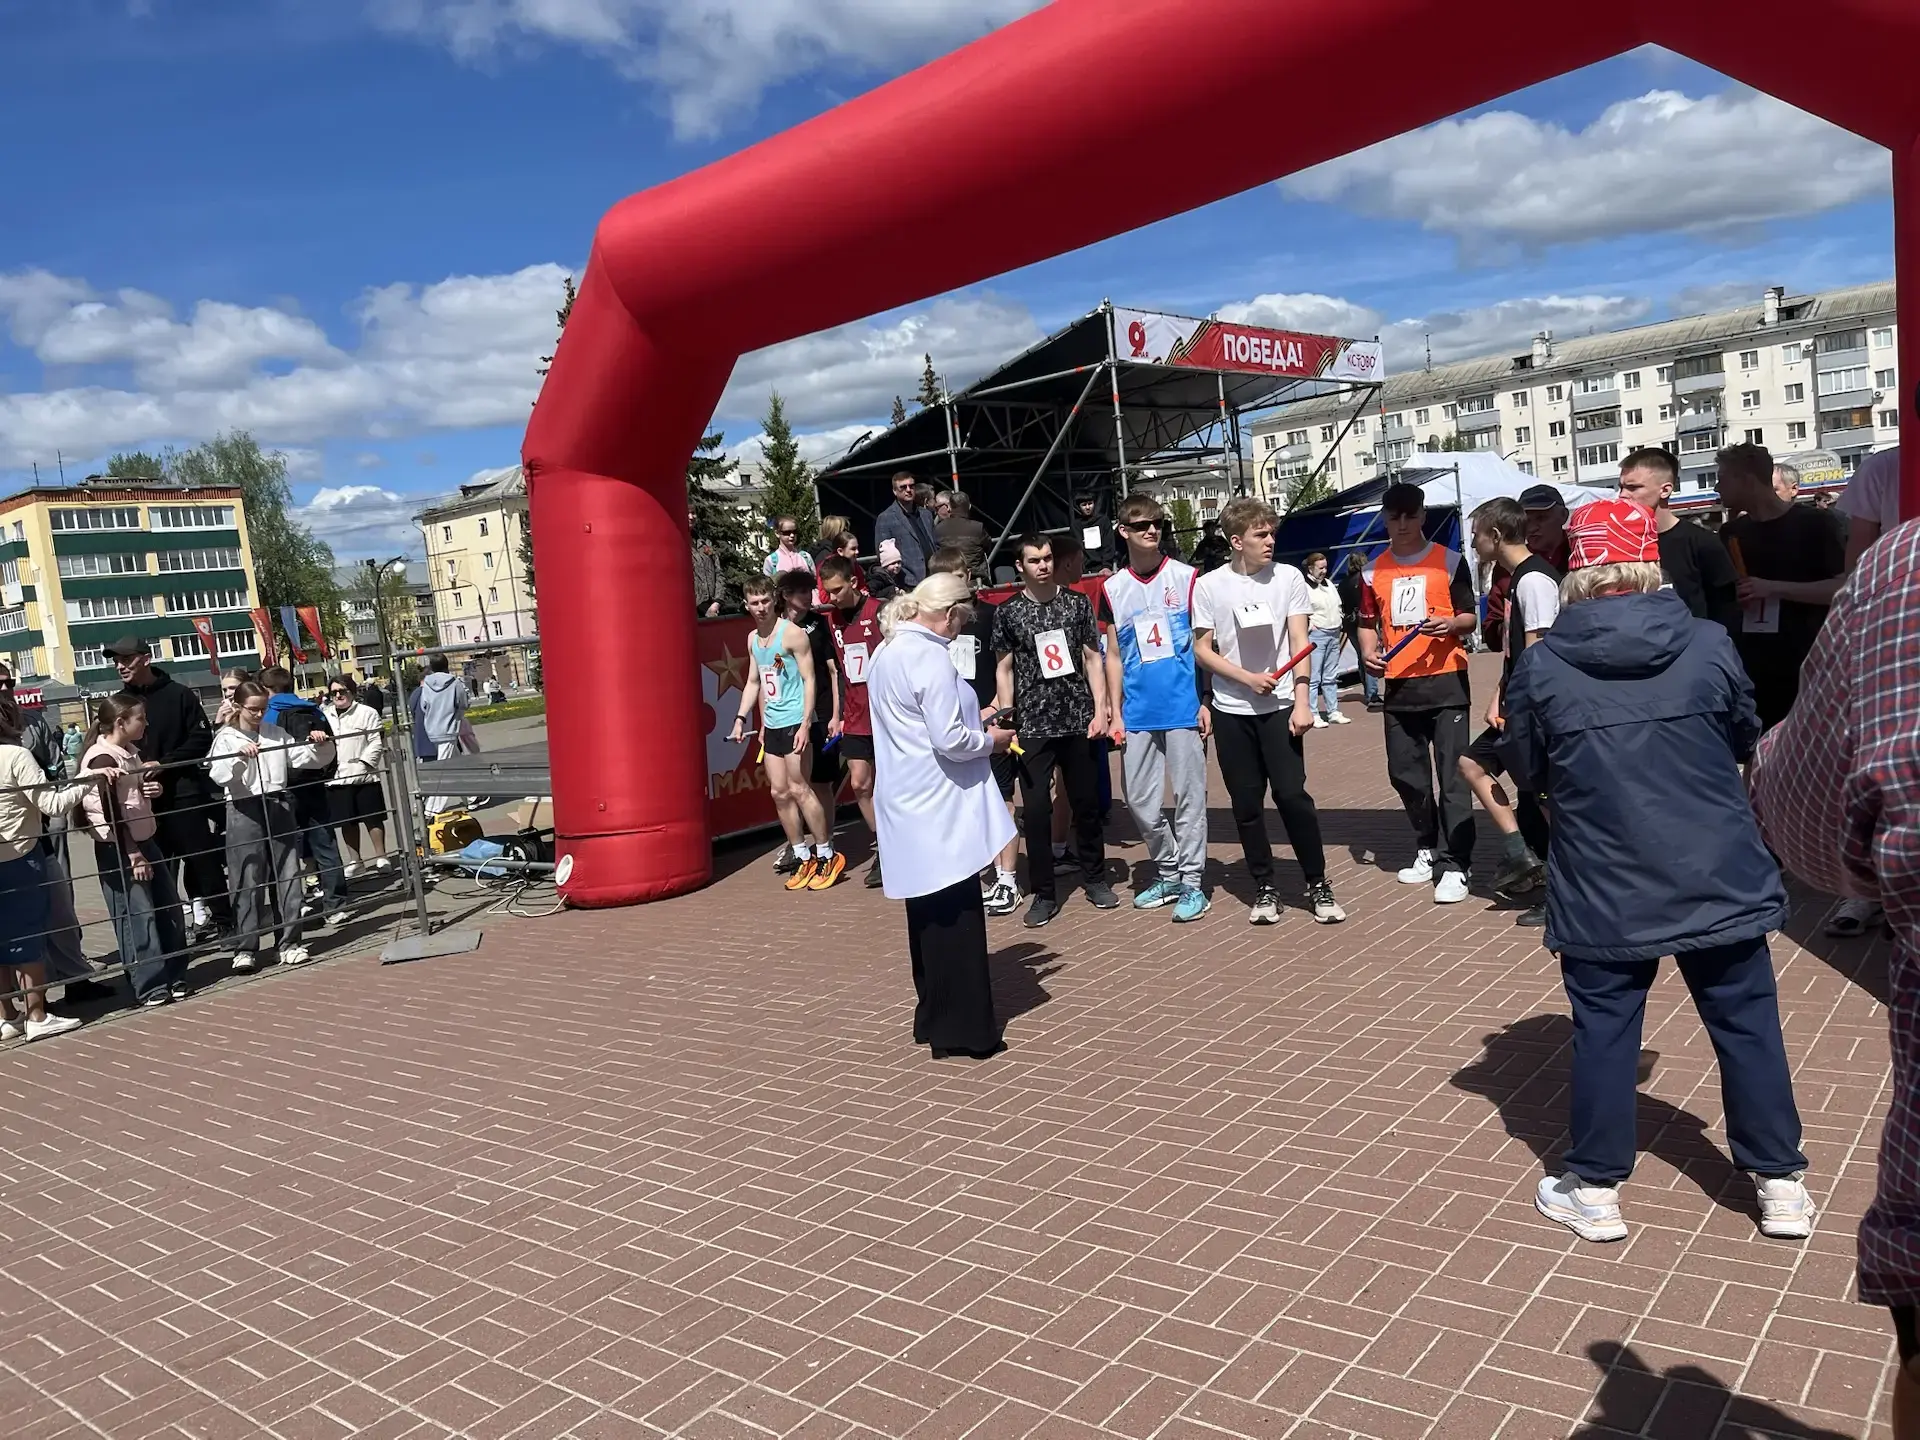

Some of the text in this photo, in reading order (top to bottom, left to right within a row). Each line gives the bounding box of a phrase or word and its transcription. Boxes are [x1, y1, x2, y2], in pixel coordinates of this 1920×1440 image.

[1129, 321, 1146, 357] 9
[1223, 333, 1304, 371] ПОБЕДА!
[1347, 354, 1376, 370] КСТОВО
[1801, 468, 1846, 484] саж
[1399, 586, 1416, 614] 12
[1146, 623, 1163, 647] 4
[852, 656, 864, 675] 7
[1044, 644, 1063, 670] 8
[764, 673, 776, 696] 5
[14, 692, 42, 704] НИТ
